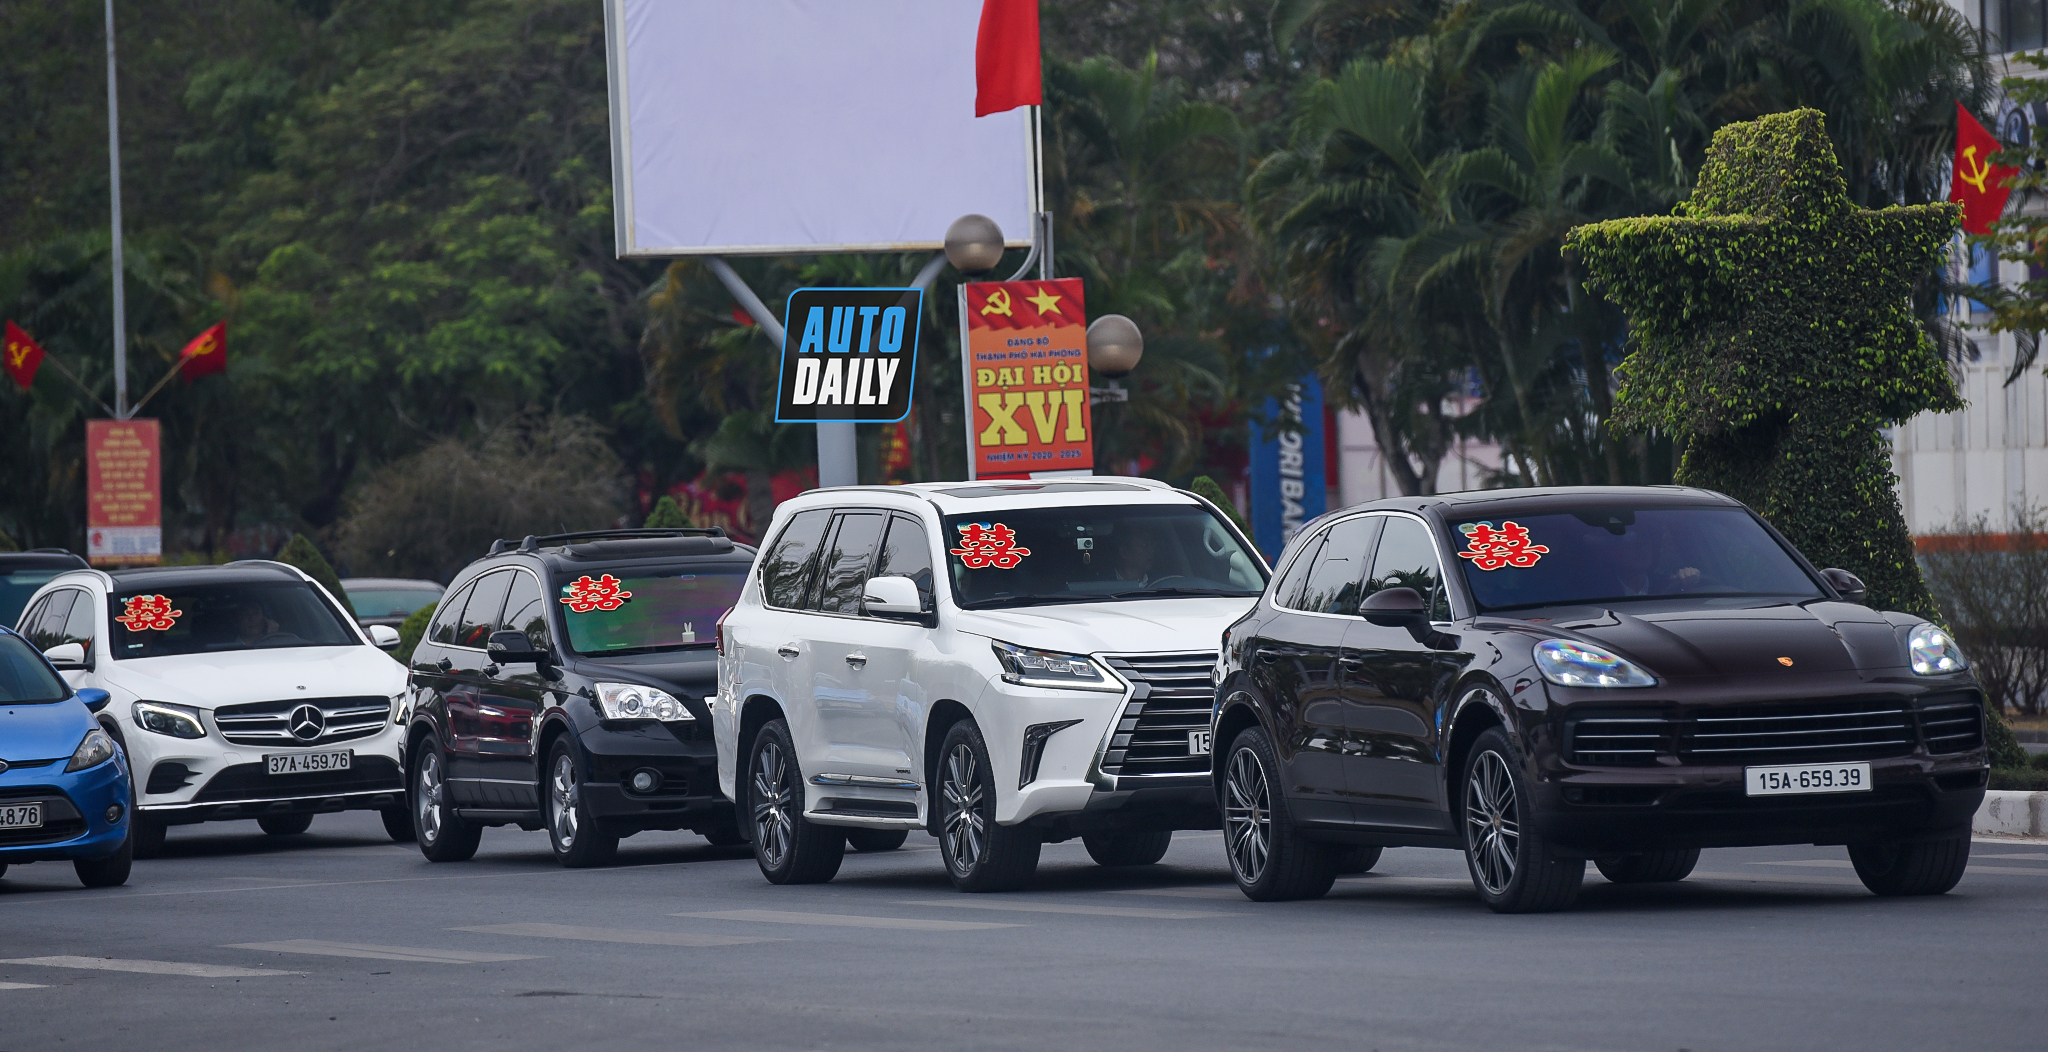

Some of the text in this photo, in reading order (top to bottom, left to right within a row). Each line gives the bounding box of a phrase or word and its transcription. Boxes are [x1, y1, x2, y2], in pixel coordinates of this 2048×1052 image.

[1007, 335, 1050, 347] ĐẢNG BỘ
[976, 347, 1082, 361] THÀNH PHỐ HẢI PHÒNG
[976, 360, 1084, 390] ĐẠI HỘI
[978, 389, 1087, 446] XVI
[987, 451, 1015, 463] NHIỆM
[1032, 451, 1053, 460] 2020
[1060, 449, 1082, 459] 2025
[270, 753, 348, 772] 37A-459.76
[1760, 769, 1861, 789] 15A-659.39
